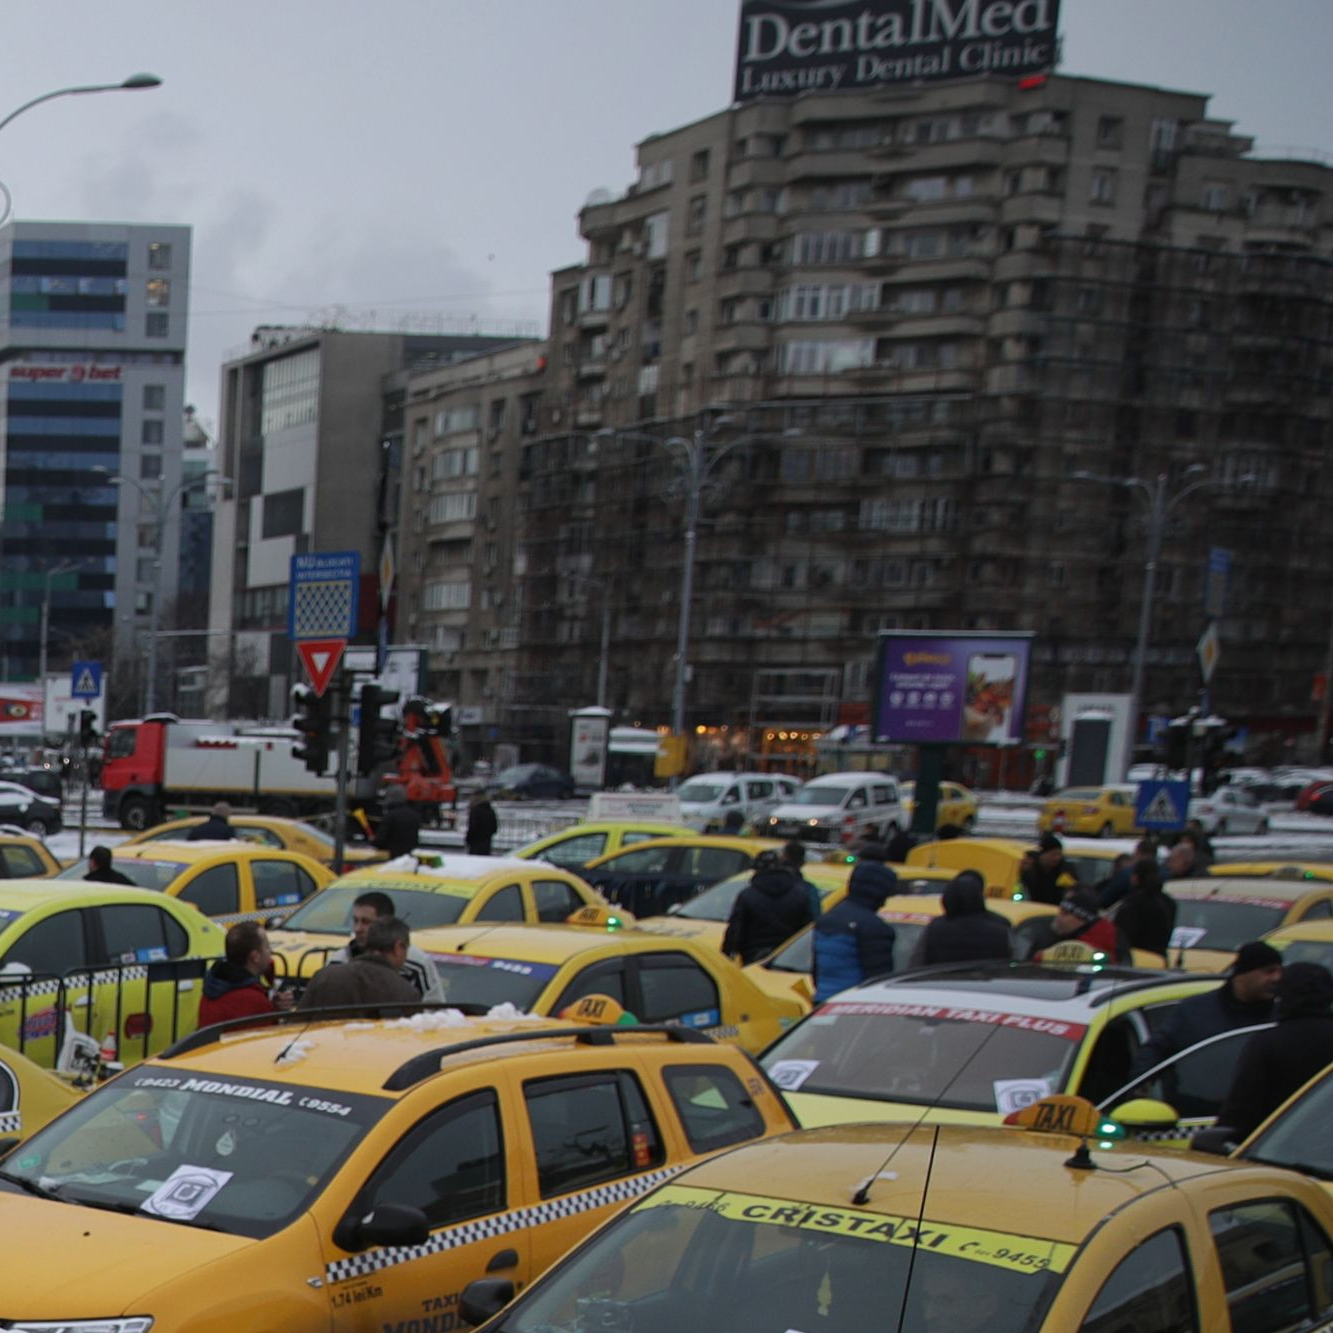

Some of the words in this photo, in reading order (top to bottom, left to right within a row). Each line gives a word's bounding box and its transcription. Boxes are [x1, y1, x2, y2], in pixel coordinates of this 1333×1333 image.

[742, 0, 1055, 62] DentalMed
[738, 64, 844, 95] Luxury
[856, 52, 951, 82] Dental
[960, 40, 1048, 74] Clinic
[10, 368, 66, 383] super
[90, 364, 121, 380] bet
[832, 1003, 940, 1017] MERIDIAN
[945, 1008, 1001, 1024] TAXI
[1002, 1014, 1071, 1036] PLUS
[180, 1078, 294, 1105] MONDIAL
[308, 1098, 352, 1117] 9554
[1034, 1103, 1077, 1131] TAXI
[742, 1204, 949, 1249] CRISTAXI
[993, 1247, 1051, 1270] 9455
